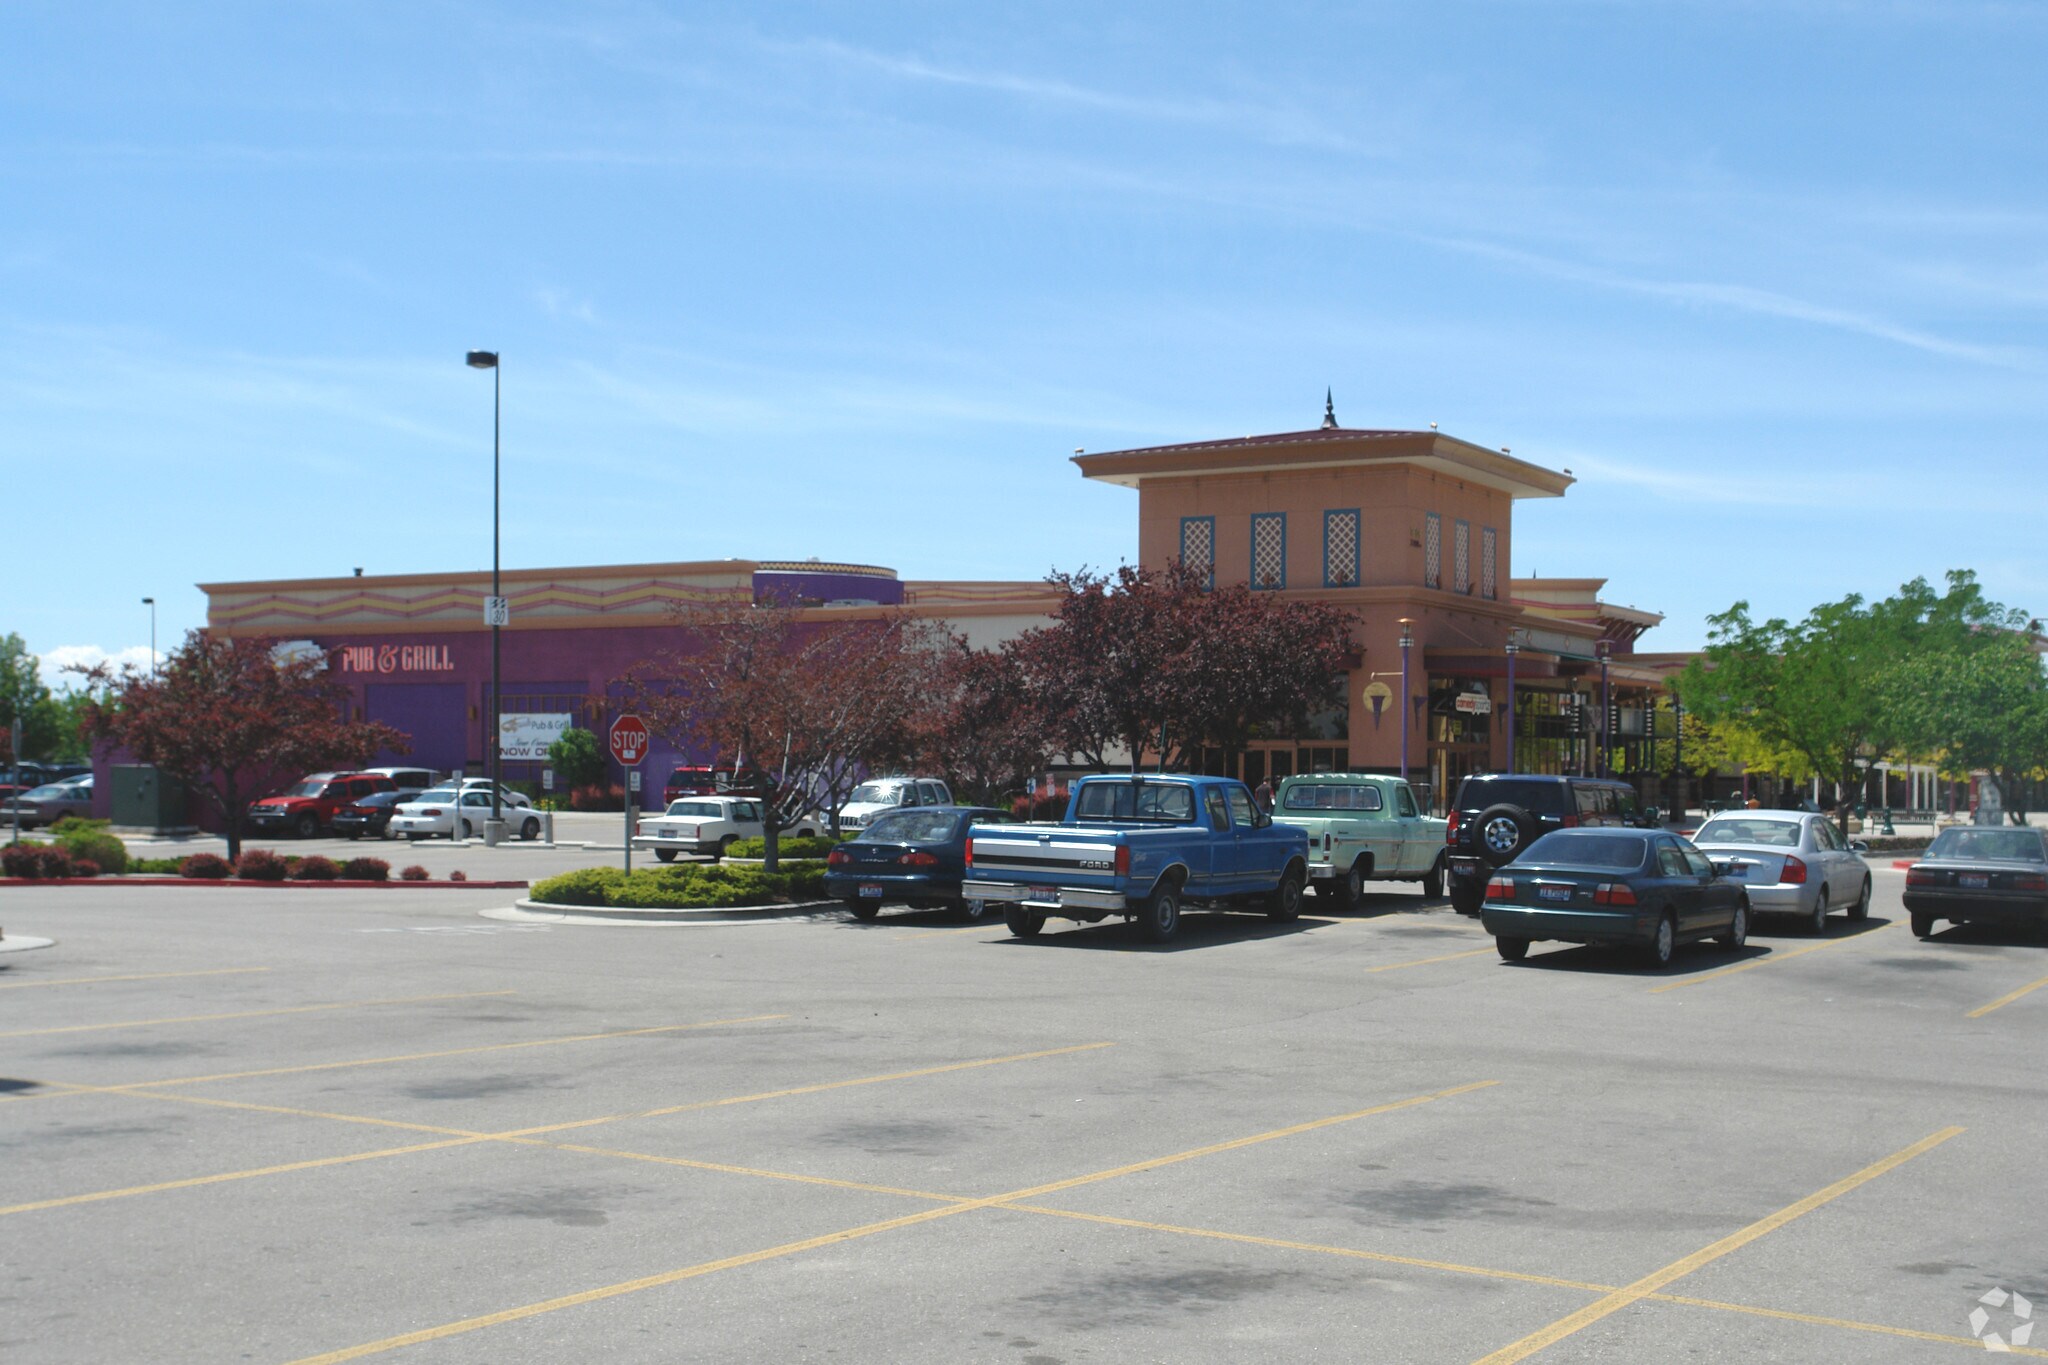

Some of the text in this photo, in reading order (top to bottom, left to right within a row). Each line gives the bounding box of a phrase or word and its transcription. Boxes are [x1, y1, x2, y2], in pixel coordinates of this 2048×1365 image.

[343, 645, 454, 673] PUB & GRILL
[531, 720, 546, 730] Pub
[613, 731, 646, 749] STOP
[499, 747, 531, 756] NOW
[1079, 860, 1110, 869] FORD
